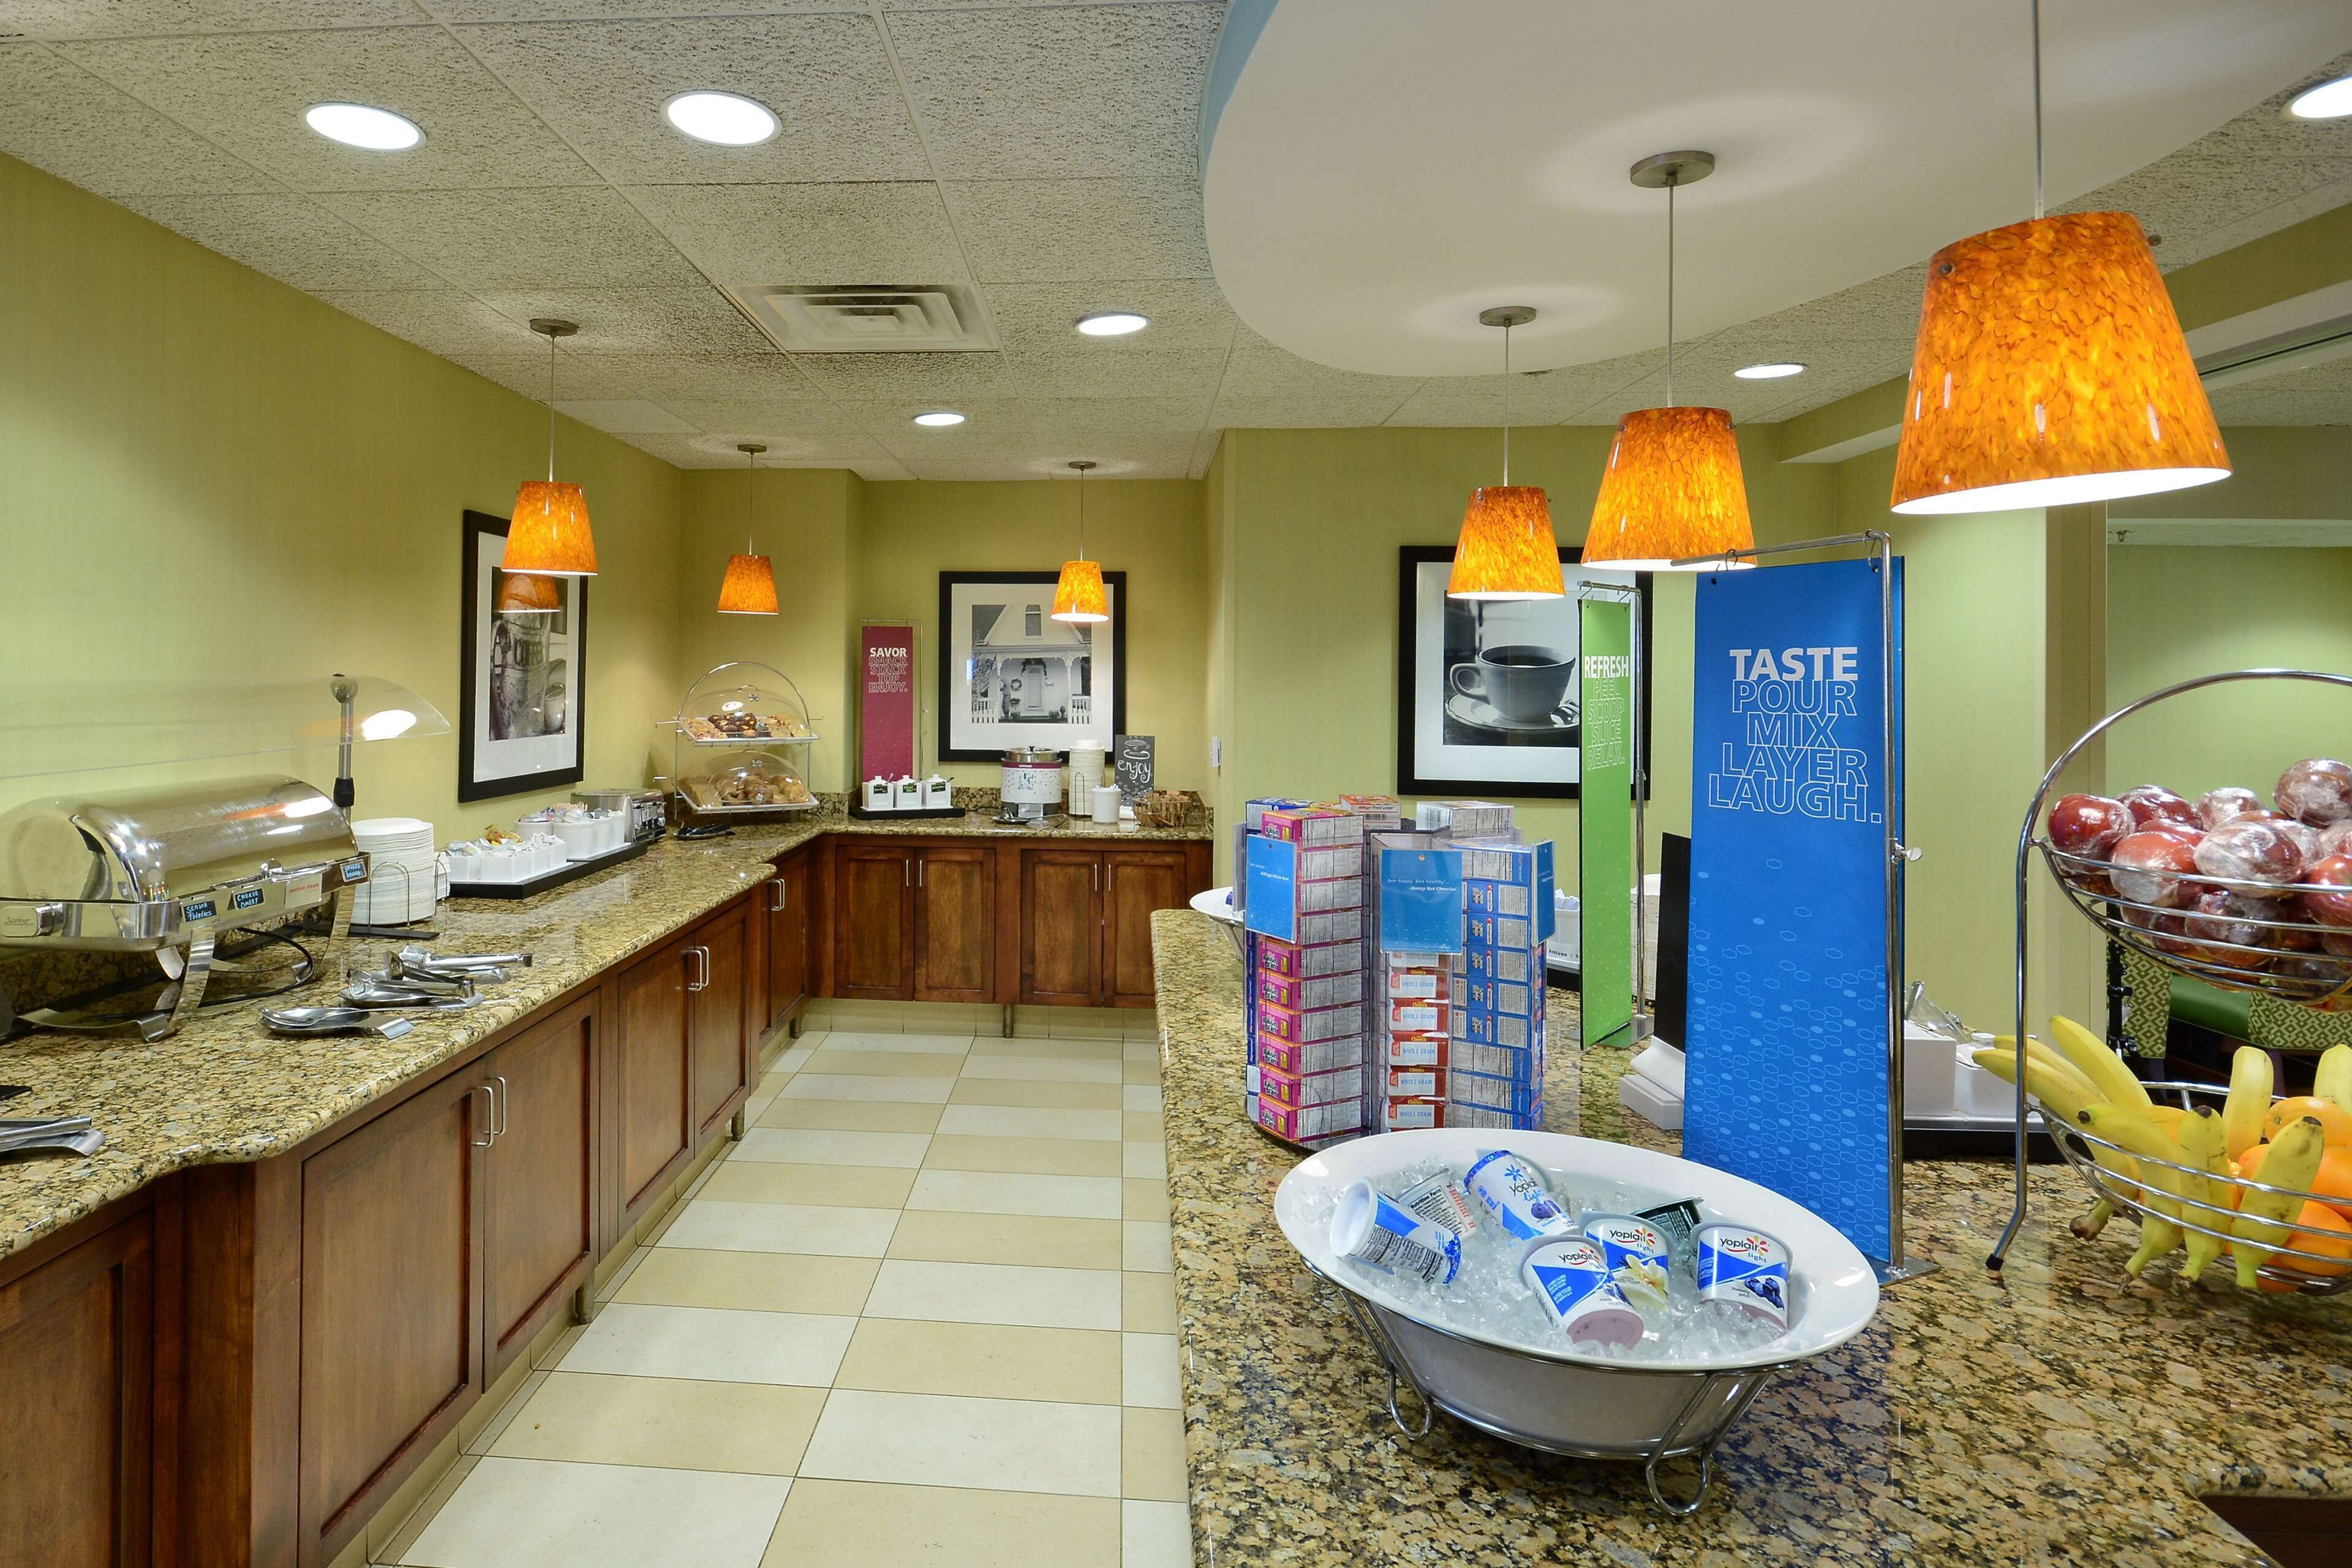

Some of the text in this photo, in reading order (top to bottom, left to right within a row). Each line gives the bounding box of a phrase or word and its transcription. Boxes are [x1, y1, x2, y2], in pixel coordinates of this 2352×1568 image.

[869, 656, 908, 666] SNACK
[870, 647, 907, 657] SAVOR
[870, 665, 907, 675] STACK
[1585, 655, 1629, 679] REFRESH
[1730, 647, 1858, 681] TASTE
[877, 673, 899, 683] TOP
[869, 682, 908, 693] ENJOY.
[1593, 677, 1619, 699] PEEL
[1732, 679, 1857, 715] POUR
[1588, 698, 1624, 725] SCOOP
[1592, 720, 1621, 745] SLICE
[1747, 712, 1839, 748] MIX
[1588, 741, 1625, 771] RELAX.
[1722, 742, 1868, 786] LAYER
[1118, 760, 1151, 783] enjoy
[1709, 774, 1882, 823] LAUGH.
[237, 891, 259, 901] CHEESE
[1610, 1229, 1646, 1243] yoplait
[1720, 1237, 1760, 1252] yoplait
[1559, 1252, 1594, 1263] yoplait
[1637, 1243, 1654, 1254] light
[1747, 1252, 1767, 1264] light
